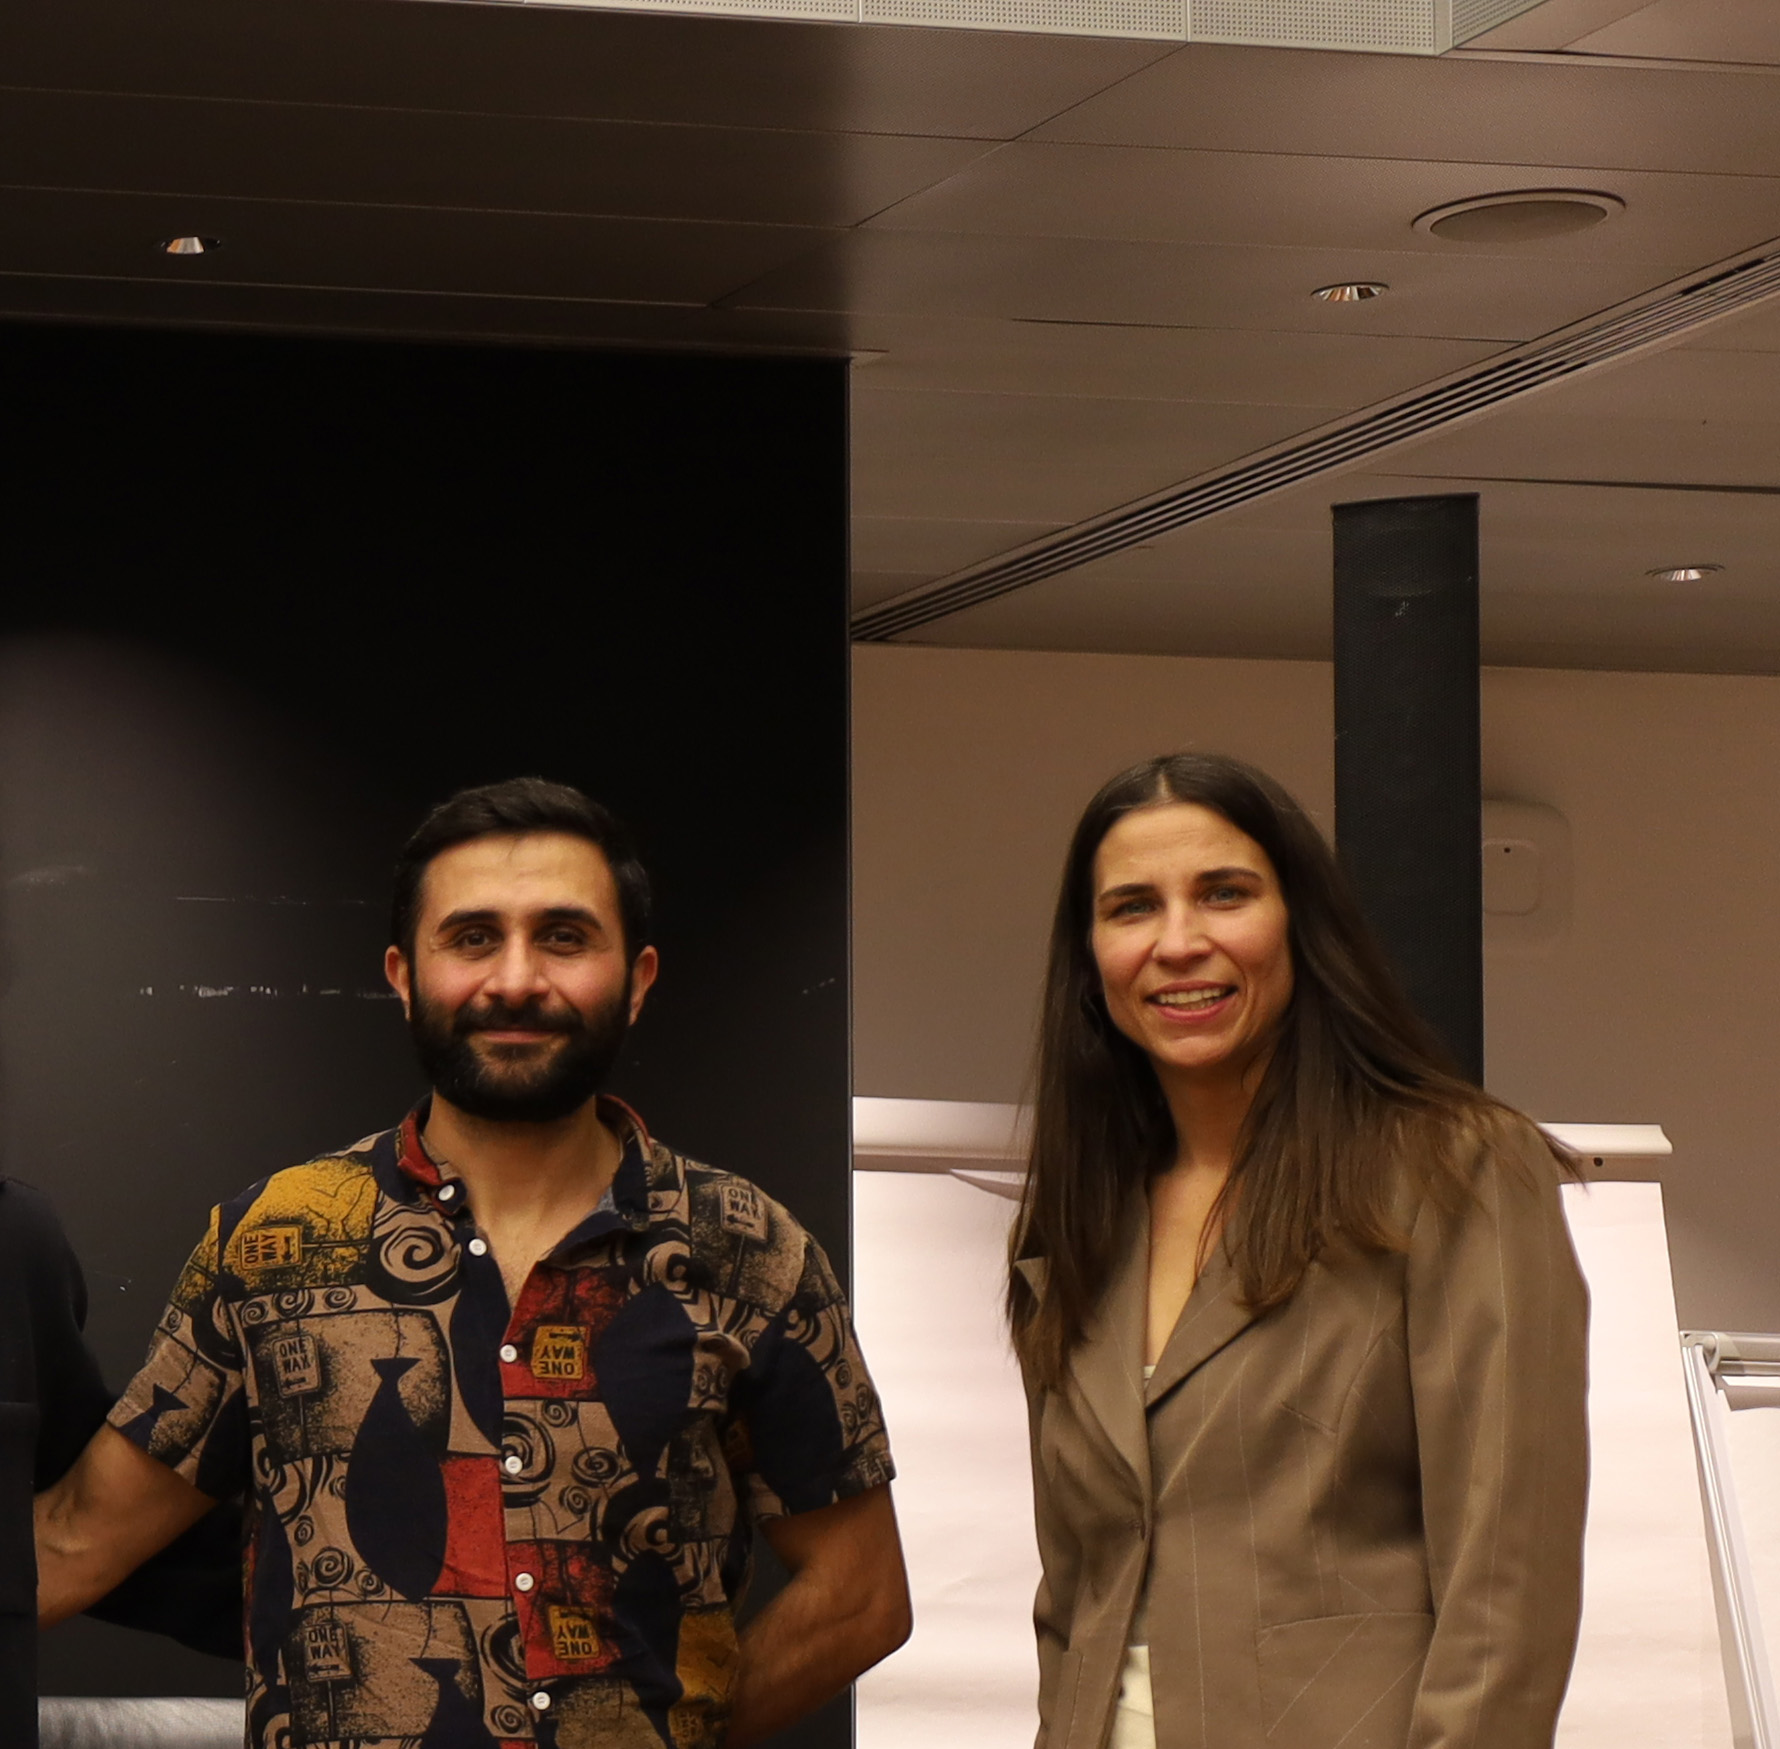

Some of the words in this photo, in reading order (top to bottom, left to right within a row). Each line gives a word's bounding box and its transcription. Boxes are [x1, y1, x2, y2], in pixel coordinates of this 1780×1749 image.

[244, 1234, 259, 1264] ONE
[261, 1234, 277, 1261] WAY
[280, 1338, 308, 1357] ONE
[540, 1345, 575, 1359] WAY
[539, 1361, 575, 1375] ONE
[308, 1625, 338, 1643] ONE
[557, 1641, 592, 1655] ONE
